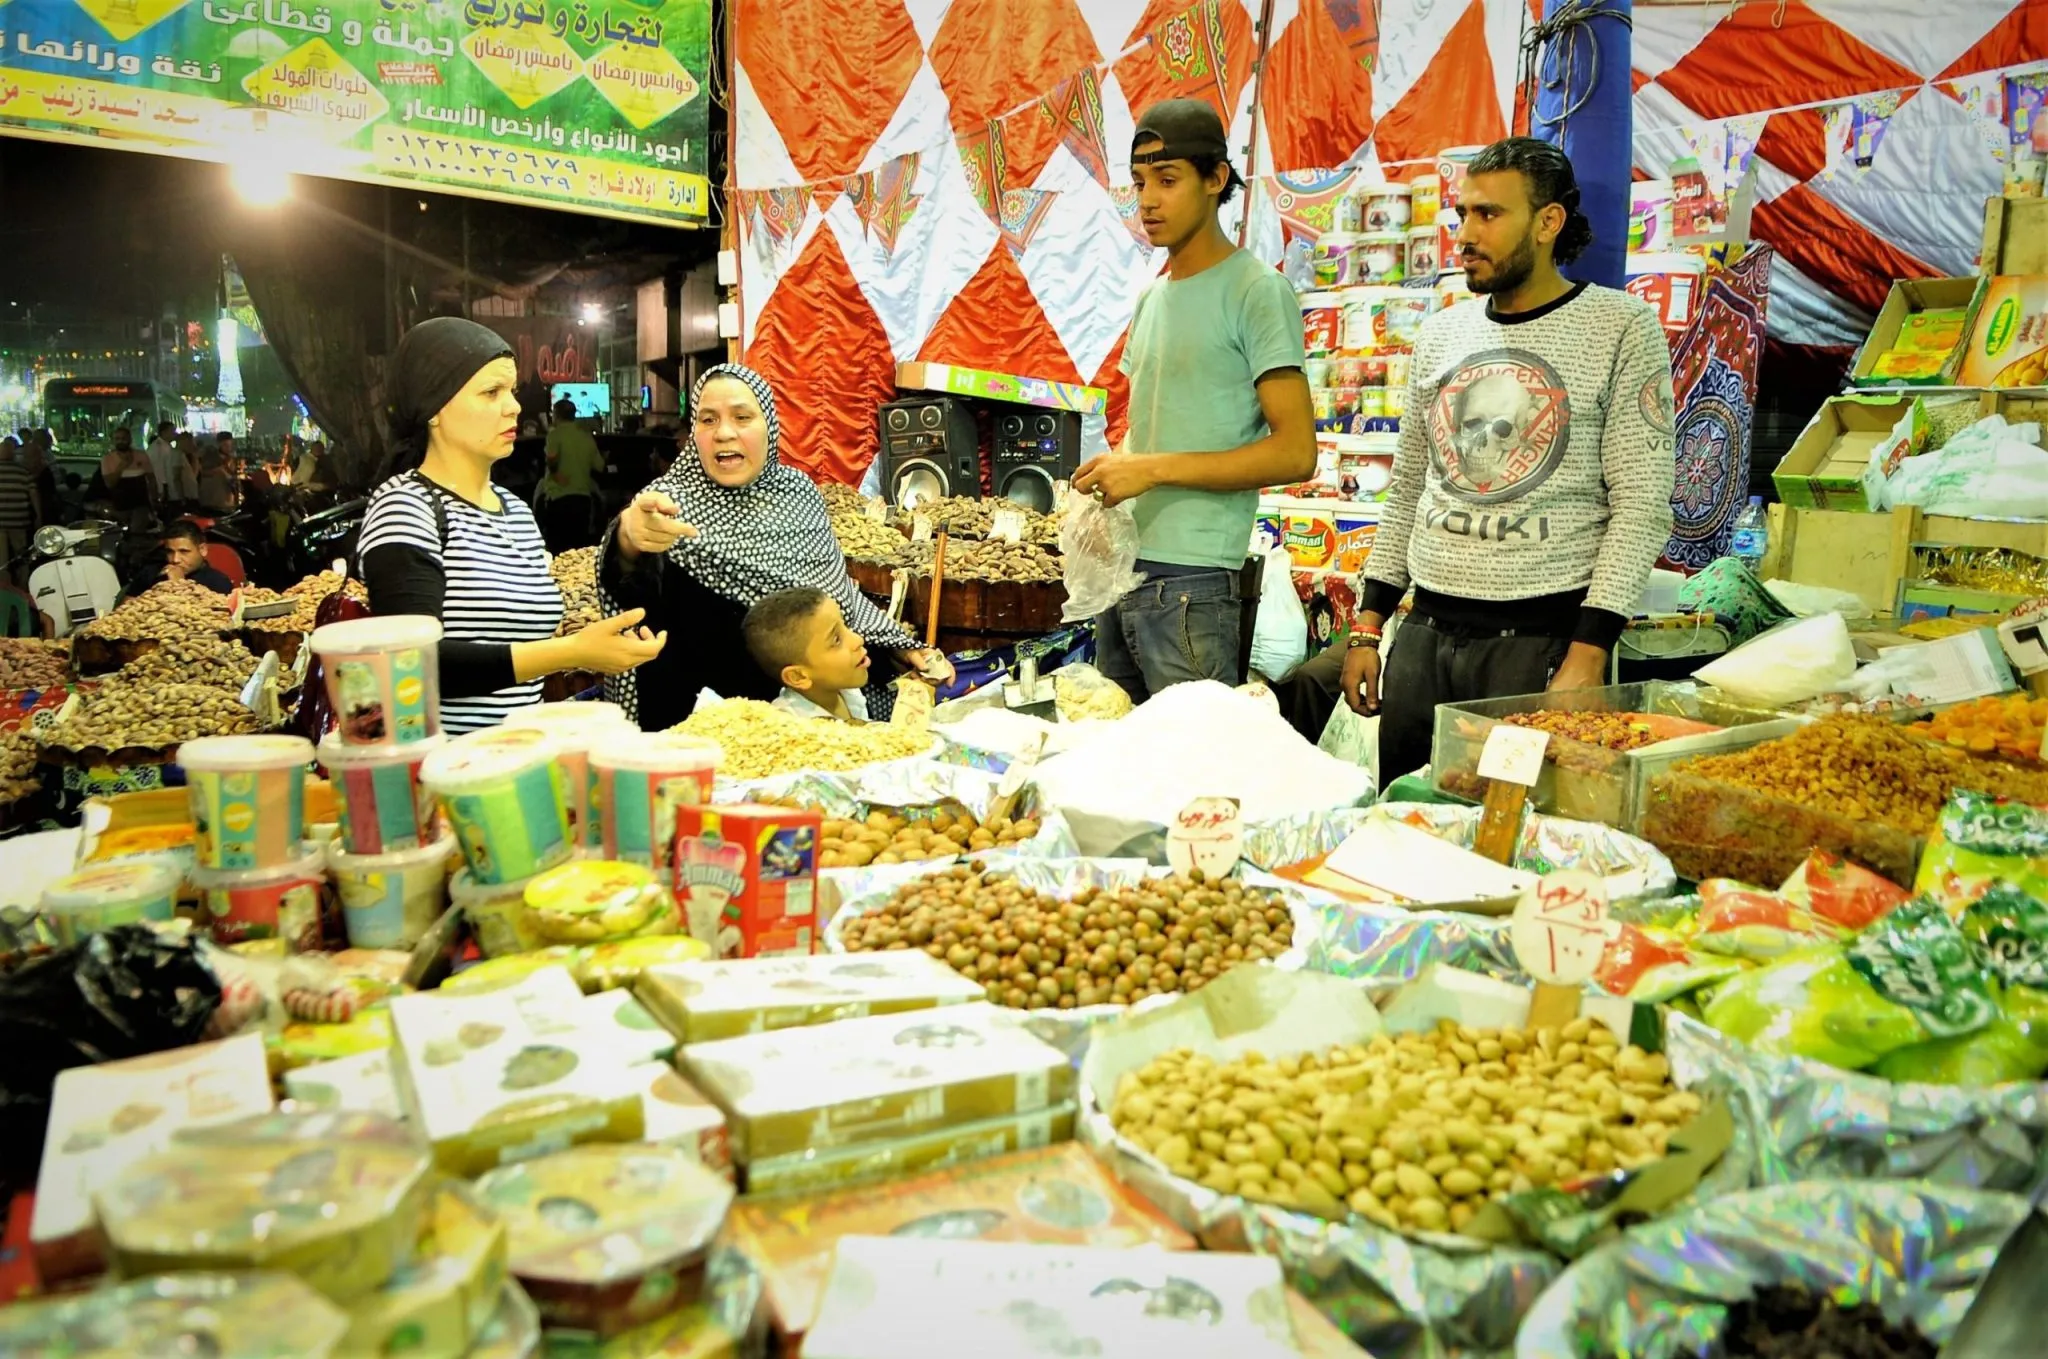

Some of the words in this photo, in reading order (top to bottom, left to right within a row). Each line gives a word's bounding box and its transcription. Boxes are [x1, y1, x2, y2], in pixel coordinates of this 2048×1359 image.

[342, 20, 362, 46] و
[550, 9, 568, 38] و
[17, 32, 141, 76] ورائها
[372, 18, 454, 63] جملة
[474, 36, 521, 67] رمضان
[151, 55, 222, 84] ثقة
[272, 63, 316, 88] المولد
[592, 58, 637, 87] رمضان
[320, 72, 368, 98] حلويات
[42, 85, 84, 117] زينب
[88, 87, 148, 123] السيدة
[402, 98, 487, 129] الأسعار
[490, 114, 565, 146] وأرخص
[570, 126, 637, 153] الأنواع
[641, 137, 689, 167] أجود
[668, 179, 697, 211] إدارة
[1456, 366, 1546, 386] DANGER
